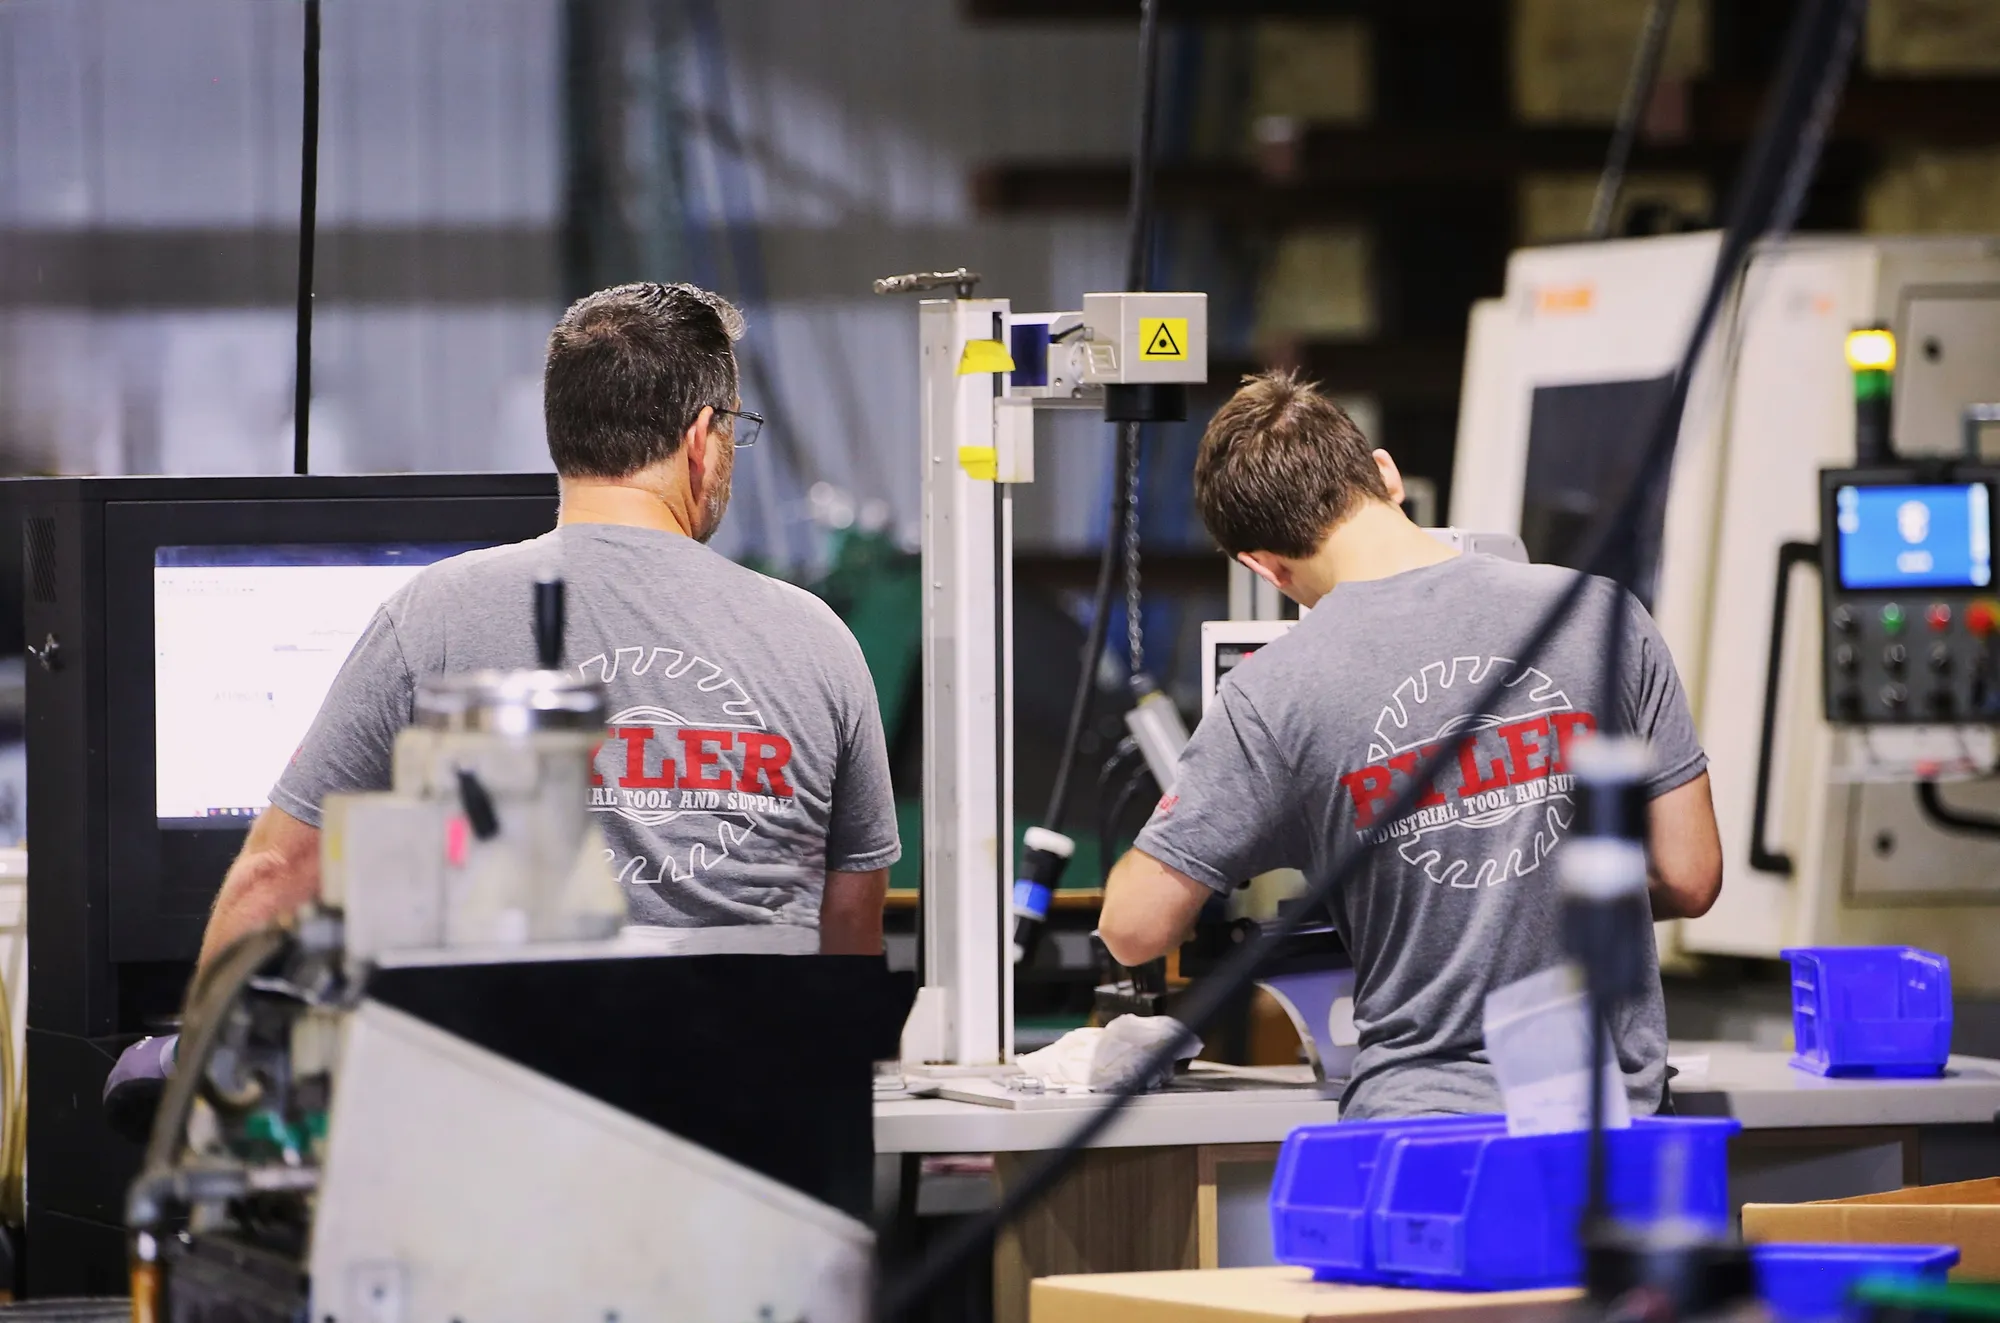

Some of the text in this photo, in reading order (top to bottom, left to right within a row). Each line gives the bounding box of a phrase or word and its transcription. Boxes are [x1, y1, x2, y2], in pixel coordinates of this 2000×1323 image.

[622, 789, 672, 809] TOOL
[679, 790, 720, 810] AND
[727, 792, 793, 814] SUPPLY
[1463, 789, 1510, 815] TOOL
[1515, 779, 1547, 803] AND
